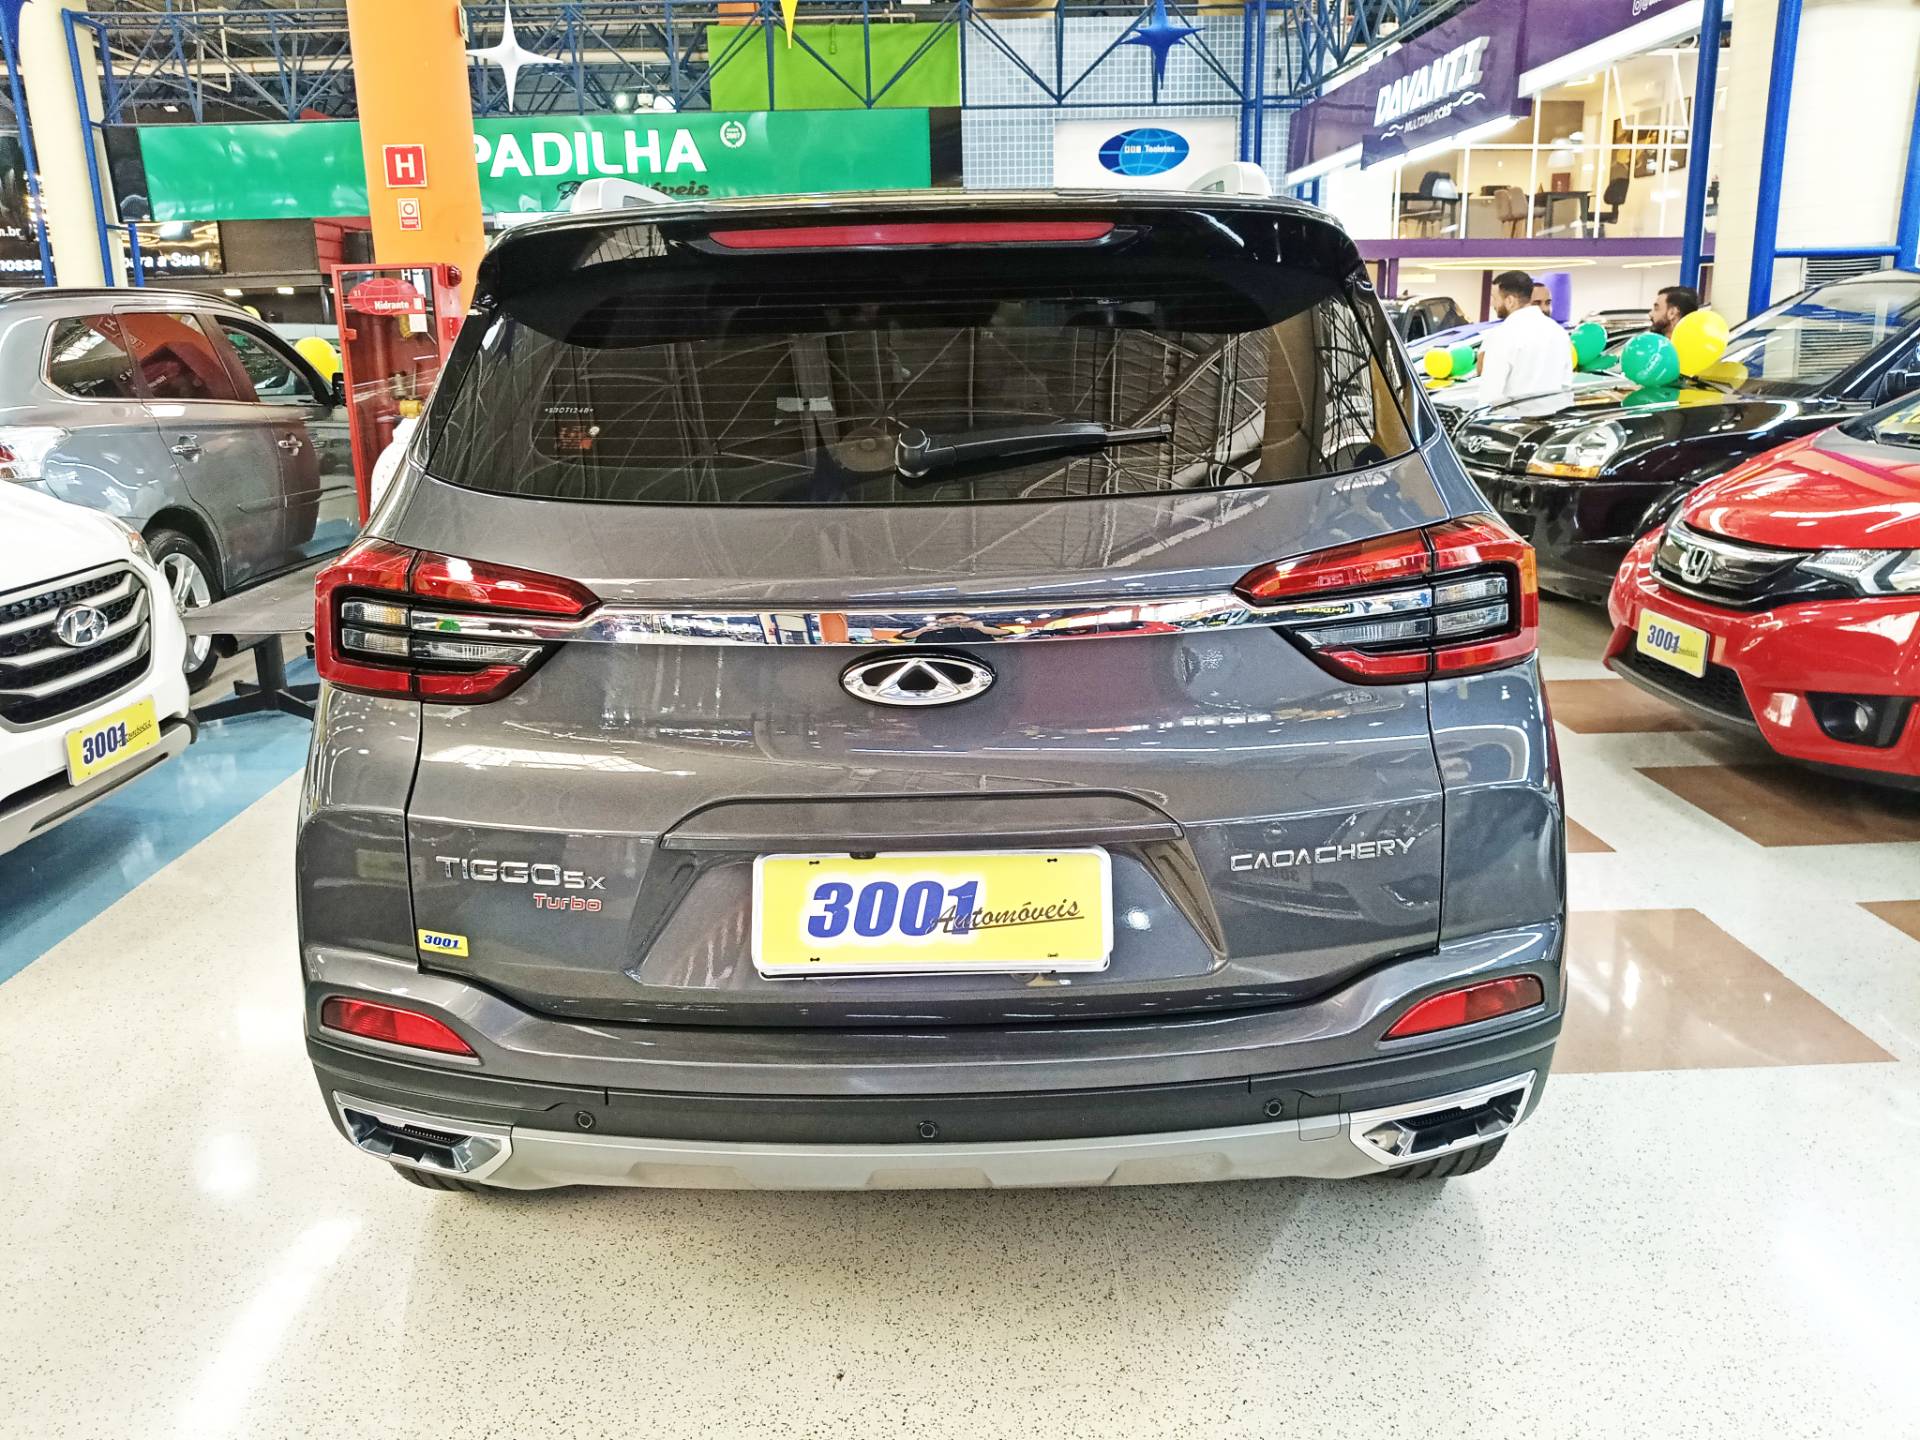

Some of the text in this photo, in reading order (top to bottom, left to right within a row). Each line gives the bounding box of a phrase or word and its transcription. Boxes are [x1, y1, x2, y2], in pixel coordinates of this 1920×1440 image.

[1374, 36, 1489, 127] DAVANTI
[395, 153, 415, 178] H
[170, 251, 200, 267] Sua
[374, 300, 410, 310] Hidrante
[1647, 624, 1680, 653] 3001
[83, 721, 127, 764] 3001
[533, 893, 602, 912] Turbo
[808, 880, 1082, 938] 3001 Automóveis
[424, 935, 459, 948] 3001
